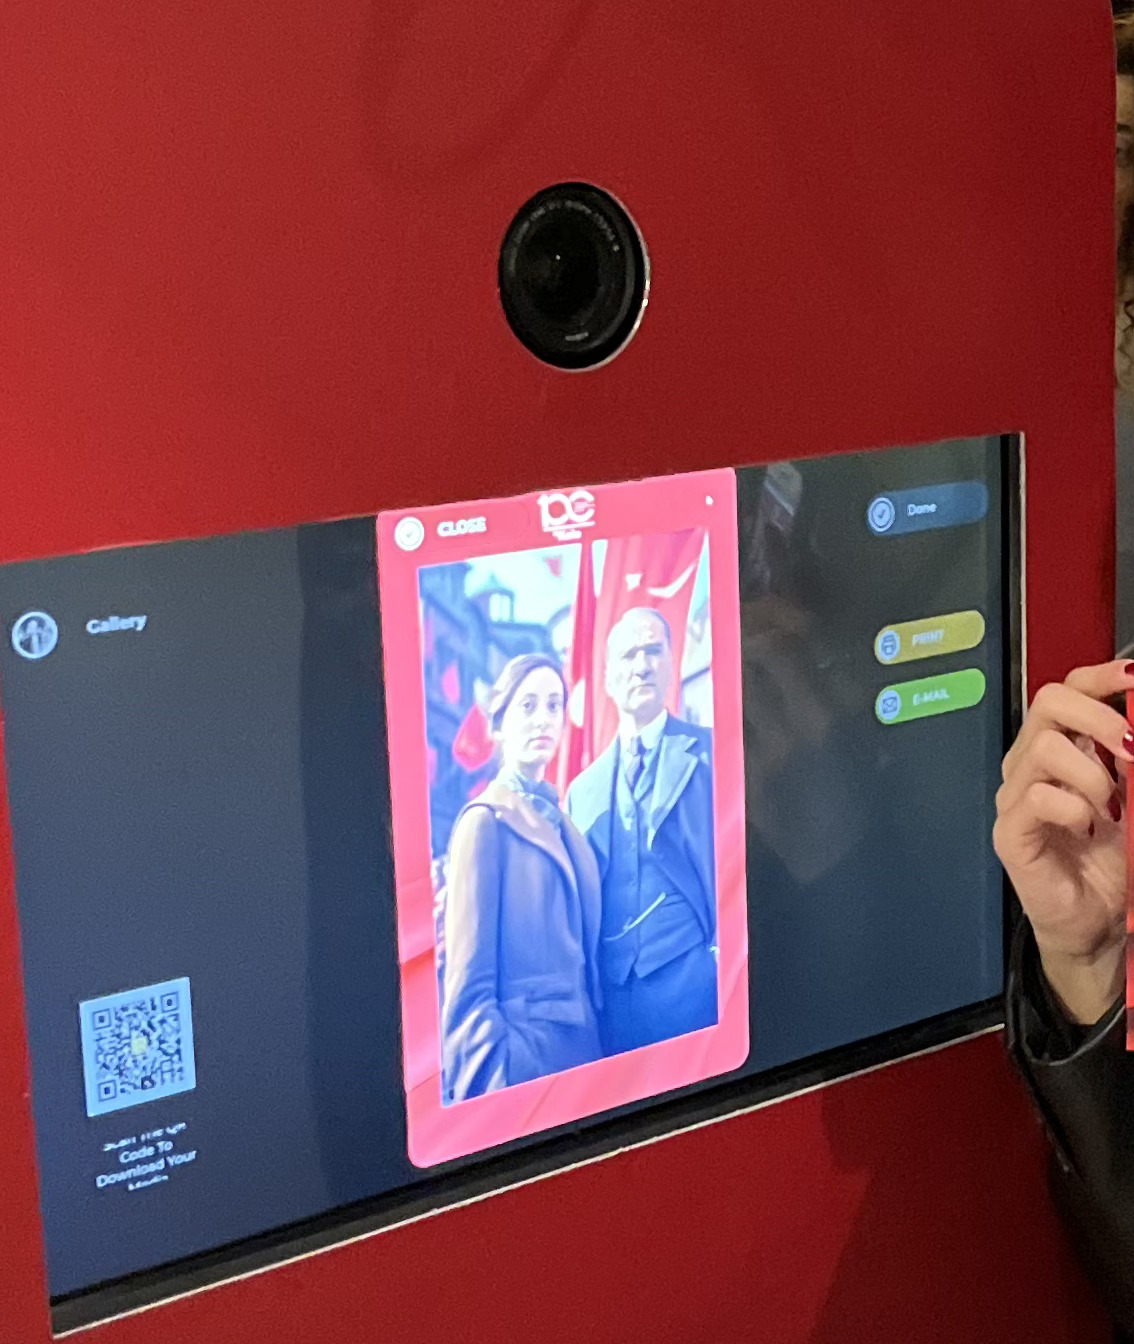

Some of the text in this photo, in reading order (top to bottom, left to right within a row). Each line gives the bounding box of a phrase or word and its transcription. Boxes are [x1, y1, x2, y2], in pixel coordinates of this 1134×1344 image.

[907, 503, 937, 516] Done
[437, 516, 487, 537] CLOSE
[86, 615, 147, 634] Gallery
[119, 1140, 173, 1164] Code To
[95, 1158, 165, 1188] Download
